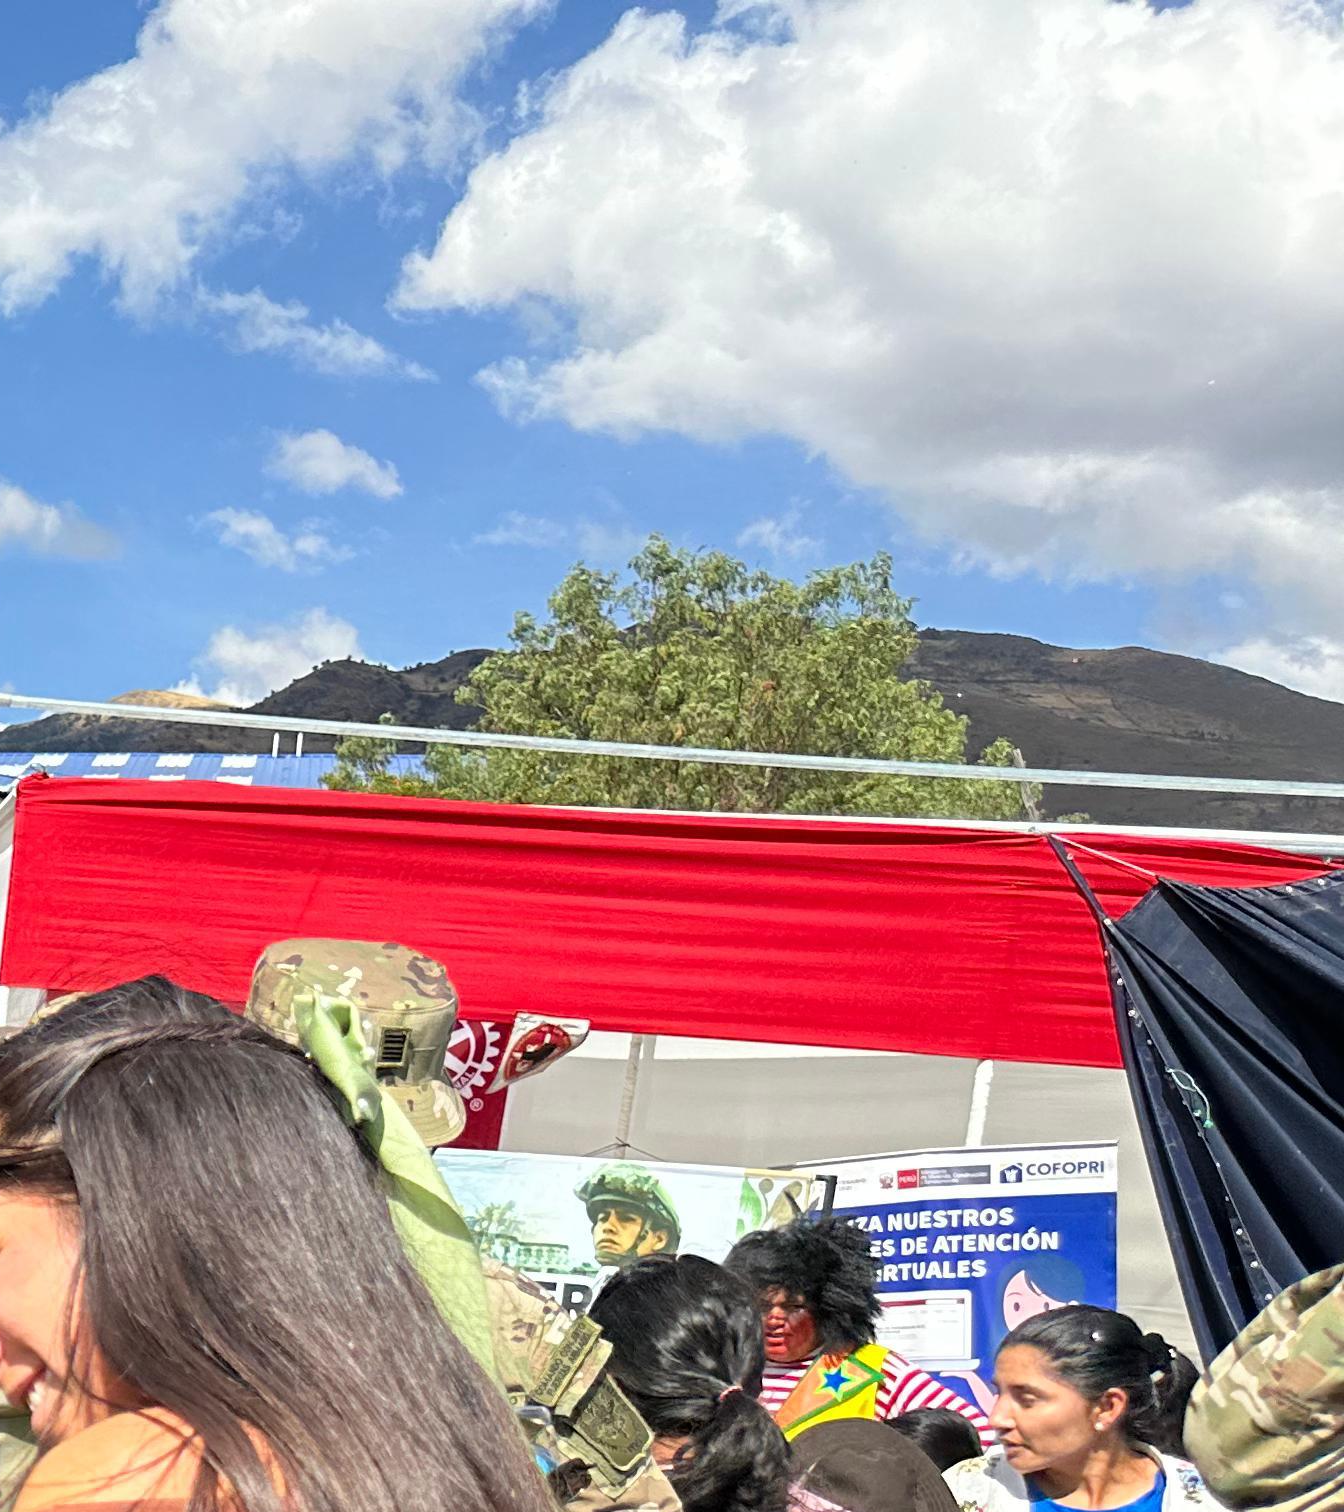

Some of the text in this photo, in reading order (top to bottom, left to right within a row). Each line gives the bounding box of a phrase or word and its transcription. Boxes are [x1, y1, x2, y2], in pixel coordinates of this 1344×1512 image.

[1026, 1160, 1105, 1176] COFOPRI
[887, 1207, 1014, 1232] NUESTROS
[869, 1227, 1059, 1258] ES DE ATENCIÓN
[875, 1260, 987, 1283] IRTUALES
